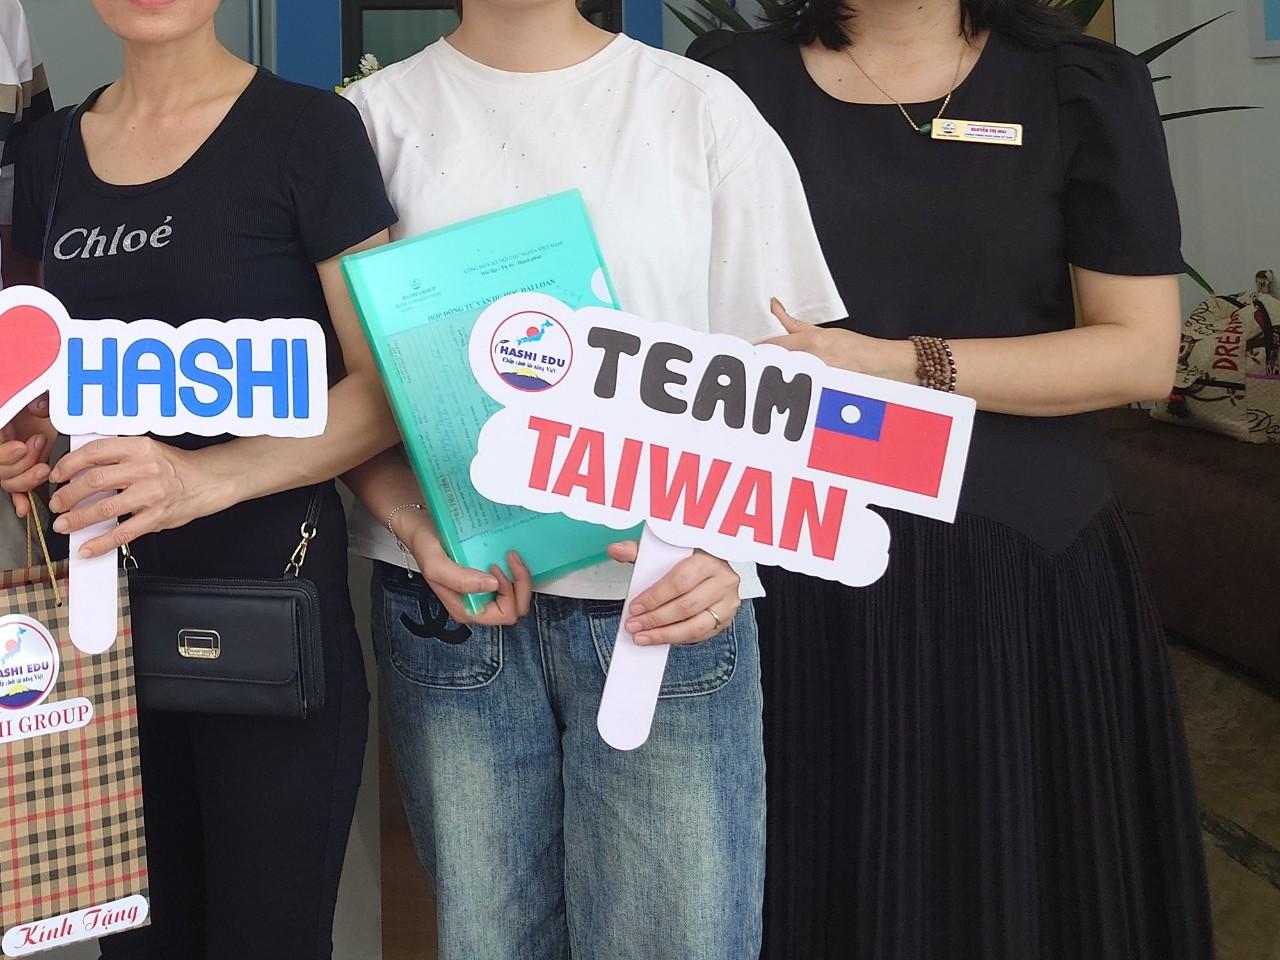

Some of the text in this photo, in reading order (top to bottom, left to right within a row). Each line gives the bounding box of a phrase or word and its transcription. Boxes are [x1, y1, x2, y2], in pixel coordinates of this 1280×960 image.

[53, 215, 173, 260] Chloé
[500, 345, 566, 368] HASHI EDU
[67, 337, 310, 419] HASHI
[587, 326, 813, 442] TEAM
[527, 415, 848, 562] TAIWAN
[27, 661, 49, 674] EDU
[18, 704, 90, 734] GROUP
[82, 904, 140, 932] Tặng
